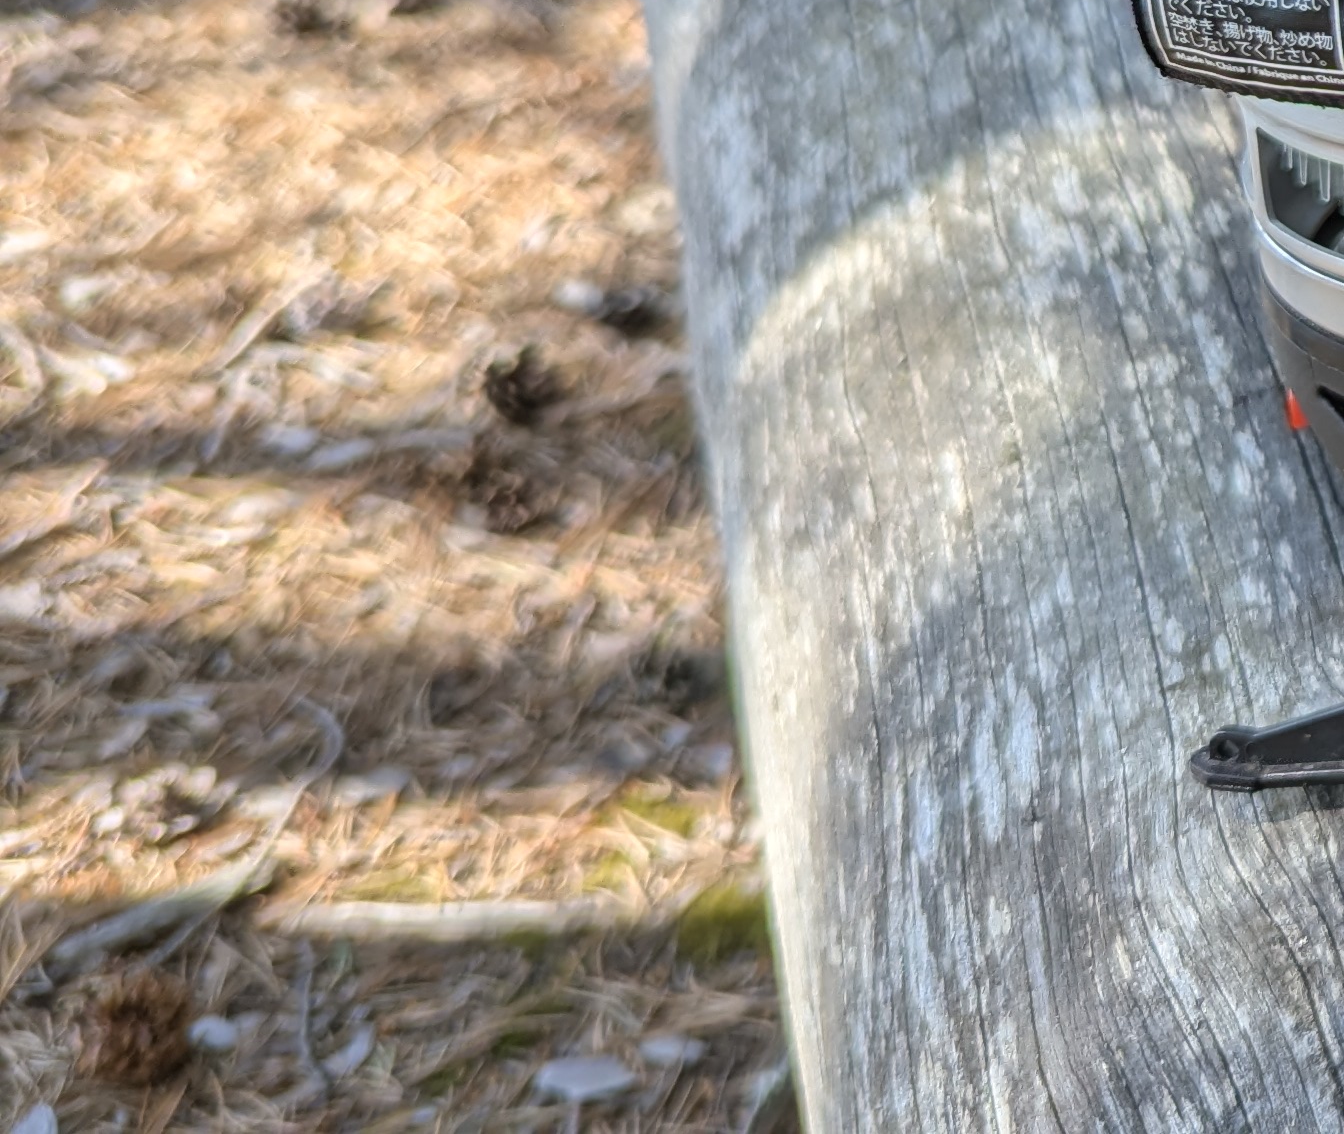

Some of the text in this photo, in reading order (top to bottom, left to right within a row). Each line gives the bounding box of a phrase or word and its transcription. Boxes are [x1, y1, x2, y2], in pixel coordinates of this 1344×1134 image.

[1173, 27, 1327, 67] はしないでください。
[1176, 51, 1205, 64] Made
[1216, 61, 1246, 74] China
[1252, 67, 1299, 81] Fabrique
